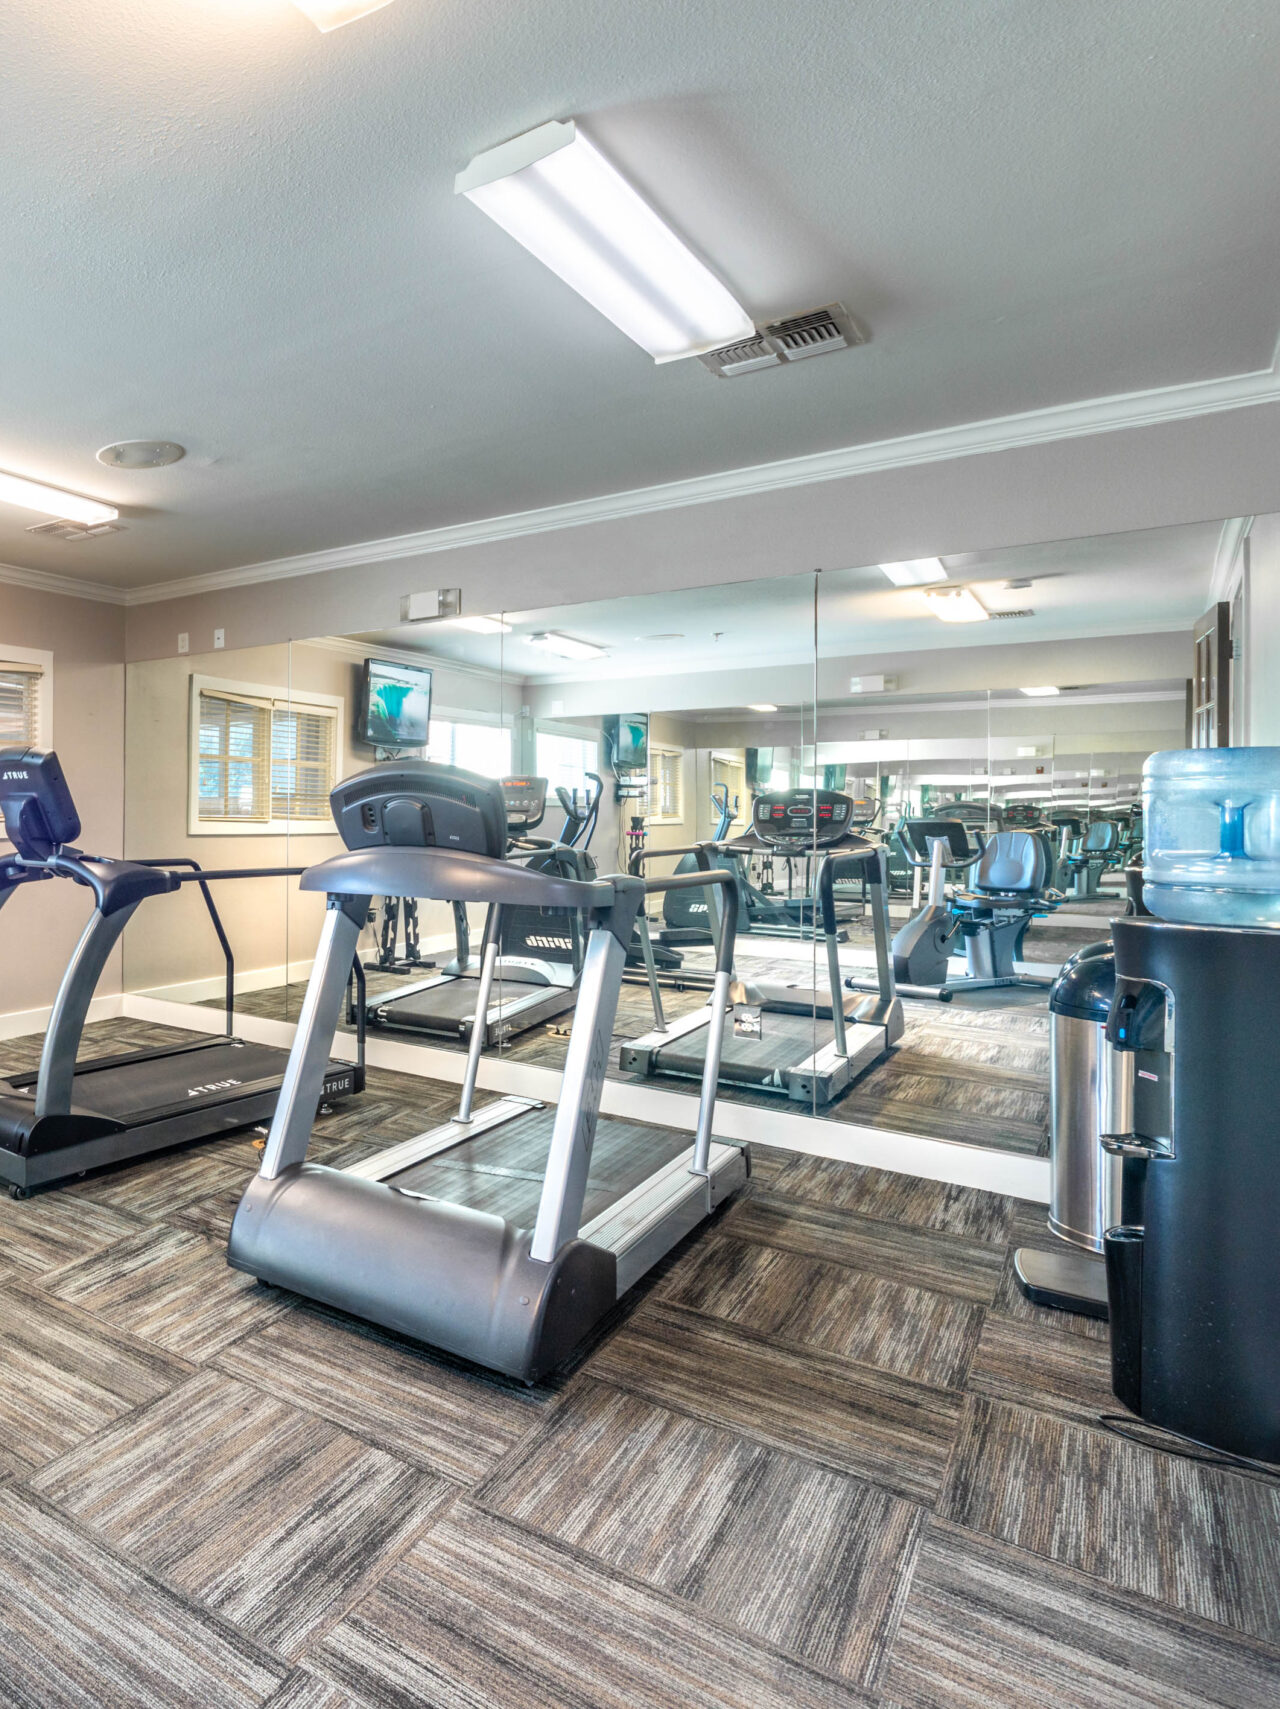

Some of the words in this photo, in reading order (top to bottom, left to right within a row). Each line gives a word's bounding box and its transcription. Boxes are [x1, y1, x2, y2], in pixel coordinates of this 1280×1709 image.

[7, 771, 29, 779] TRUE
[194, 1079, 242, 1093] TRUE
[326, 1078, 350, 1093] TRUE
